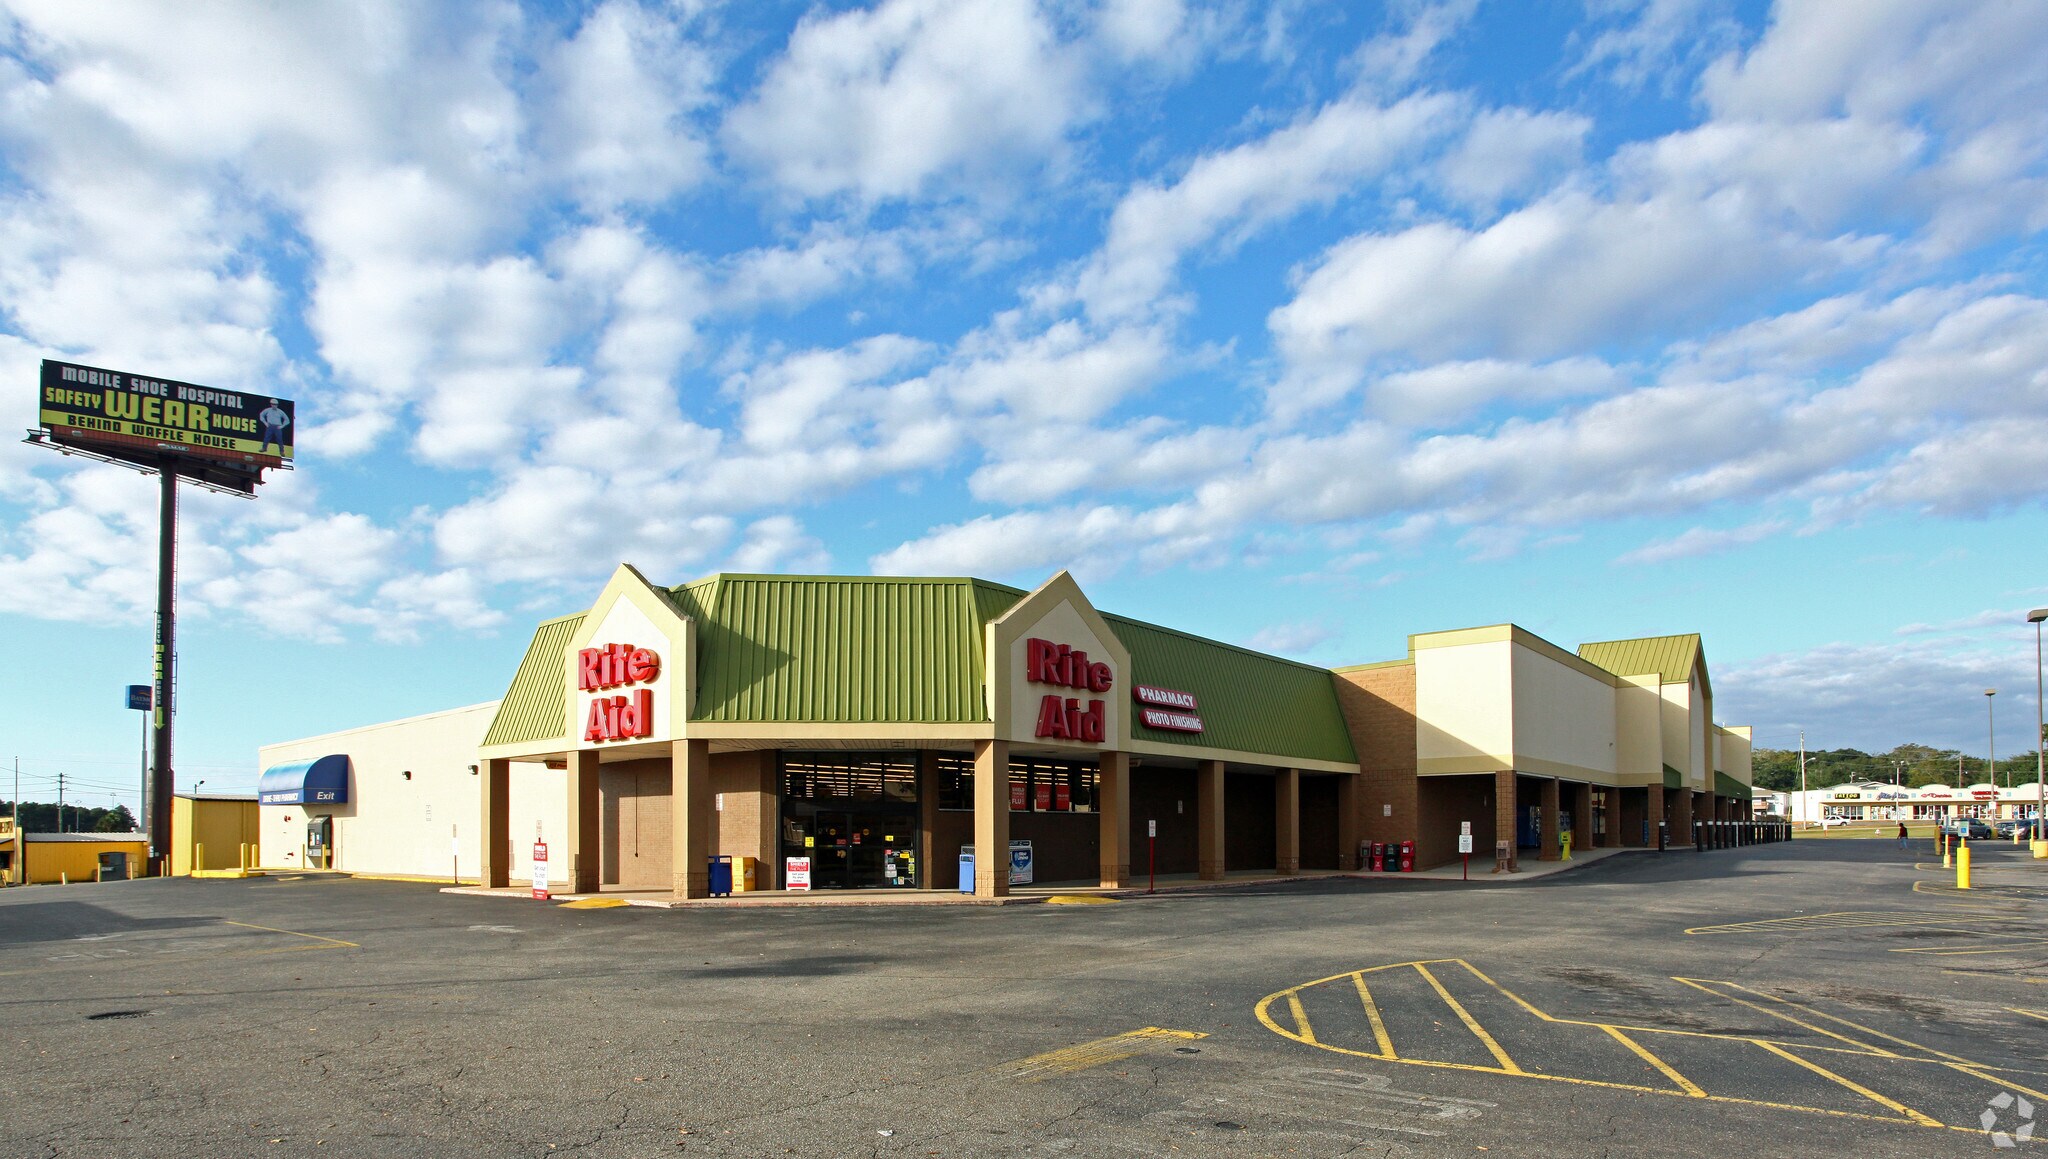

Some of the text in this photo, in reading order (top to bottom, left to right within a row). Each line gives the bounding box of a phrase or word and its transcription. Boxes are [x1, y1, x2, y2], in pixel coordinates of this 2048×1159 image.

[45, 387, 102, 409] SAFETY
[62, 366, 243, 409] MOBILE SHOE HOSPITAL
[104, 390, 210, 431] WEAR
[212, 413, 257, 433] HOUSE
[67, 414, 122, 432] BEHIND
[131, 424, 184, 442] WAFFLE
[193, 433, 236, 449] HOUSE
[577, 642, 661, 693] Rite
[1026, 637, 1113, 693] Rite
[584, 688, 654, 743] Aid
[1139, 687, 1194, 707] PHARMACY
[1035, 694, 1105, 743] Aid
[1146, 710, 1202, 731] PHOTO FINISHING
[316, 791, 335, 800] Exit
